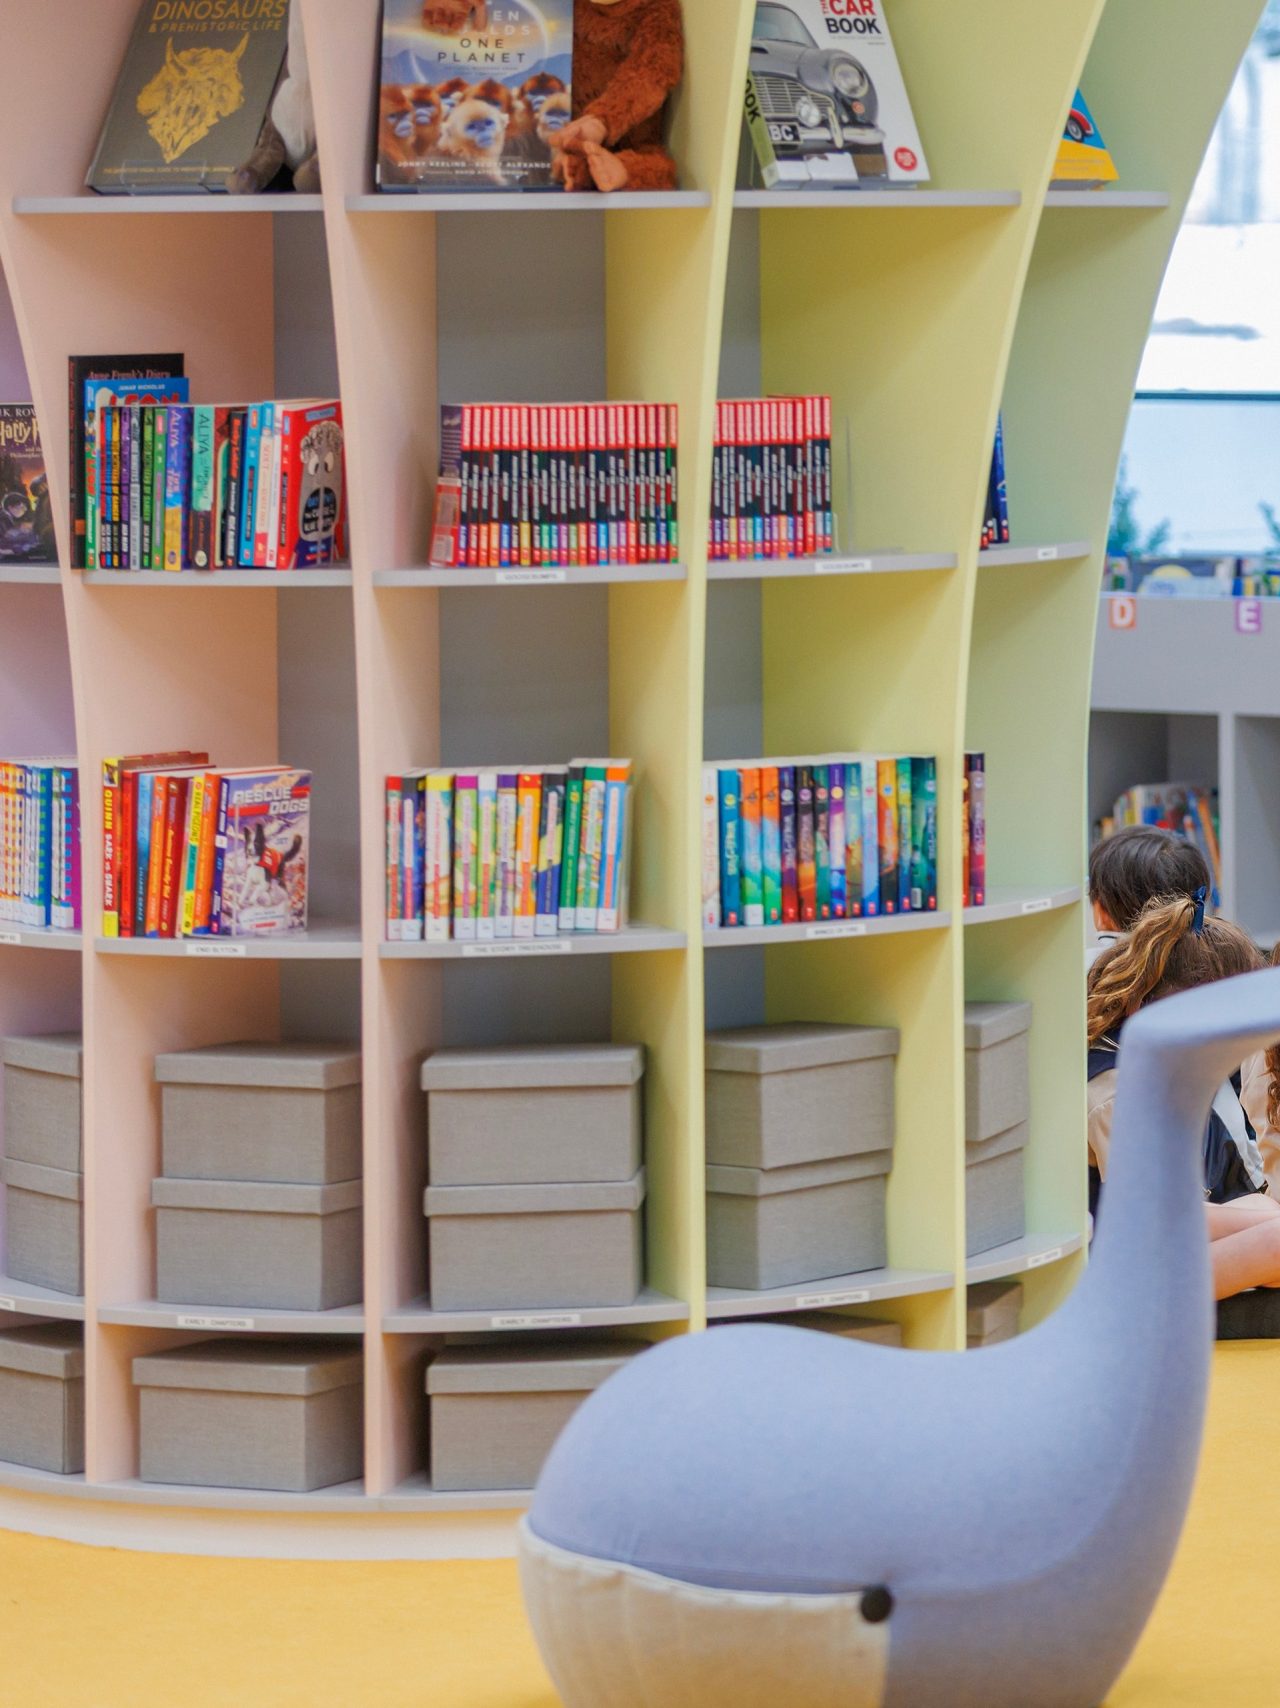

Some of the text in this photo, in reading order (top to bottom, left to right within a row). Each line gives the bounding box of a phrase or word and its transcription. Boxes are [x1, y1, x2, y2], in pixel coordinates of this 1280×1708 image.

[153, 0, 286, 21] DINOSAURS
[829, 0, 876, 16] CAR
[161, 22, 249, 32] PREHISTORIC
[253, 21, 282, 31] LIFE
[825, 18, 881, 34] BOOK
[460, 38, 505, 48] ONE
[437, 52, 526, 64] PLANET
[168, 410, 181, 448] ALIYA
[198, 414, 210, 454] ALIYA
[1112, 600, 1133, 626] D
[1238, 601, 1258, 630] E
[233, 786, 293, 804] RESCUE
[268, 798, 309, 815] DOGS
[210, 1319, 246, 1327] CHAPTERS
[531, 1316, 573, 1324] CHAPTERS
